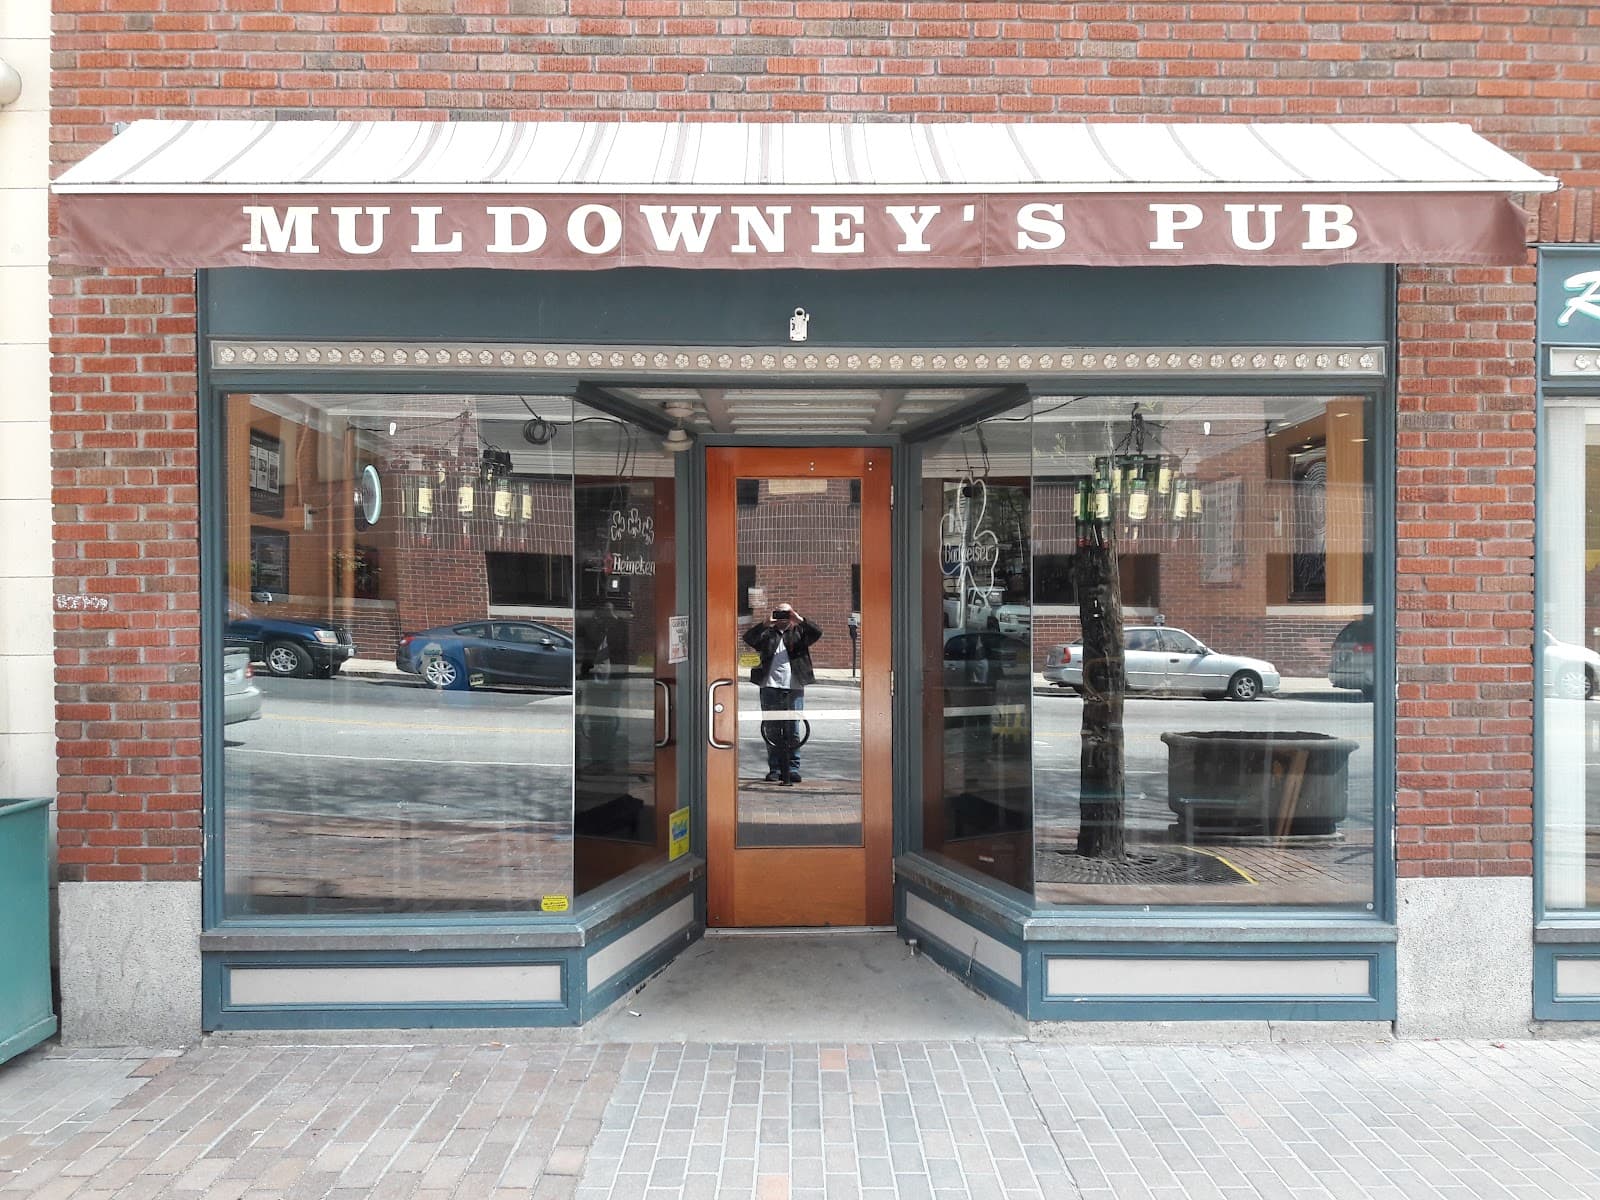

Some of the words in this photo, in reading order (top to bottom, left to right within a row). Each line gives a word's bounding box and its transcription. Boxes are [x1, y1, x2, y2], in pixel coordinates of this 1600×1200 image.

[242, 202, 1066, 255] MULDOWNEY'S
[1149, 203, 1359, 251] PUB
[611, 552, 656, 575] Heineken
